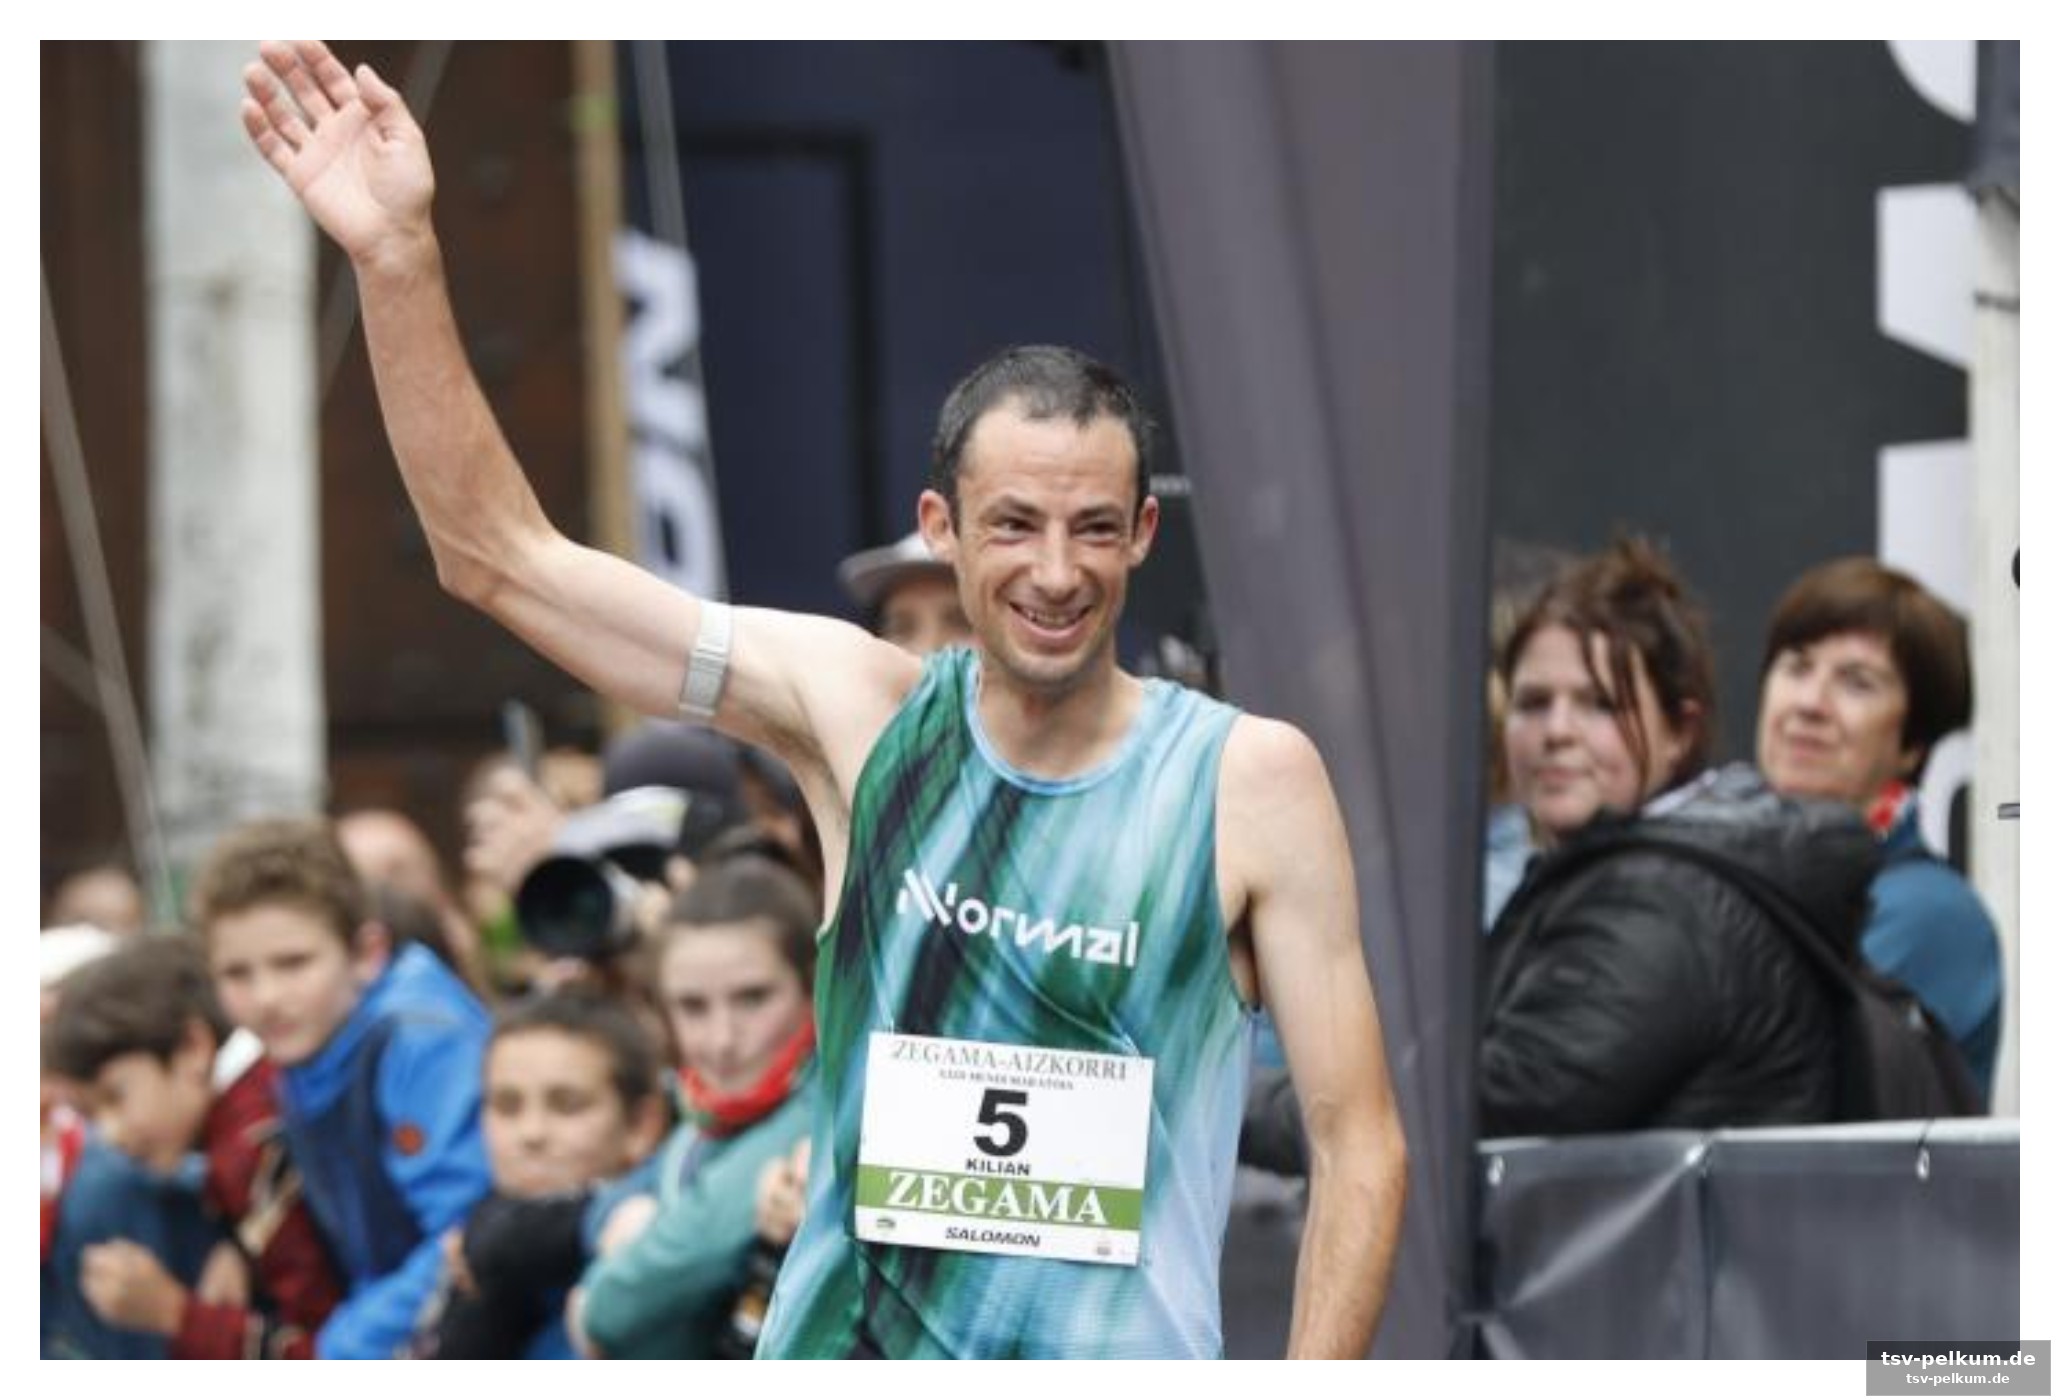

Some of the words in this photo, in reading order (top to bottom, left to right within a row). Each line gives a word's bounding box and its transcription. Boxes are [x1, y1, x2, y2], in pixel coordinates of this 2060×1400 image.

[973, 1088, 1029, 1157] 5
[965, 1157, 1031, 1177] KILIAN
[886, 1171, 1108, 1225] ZEGAMA
[945, 1226, 1041, 1248] SALOMON
